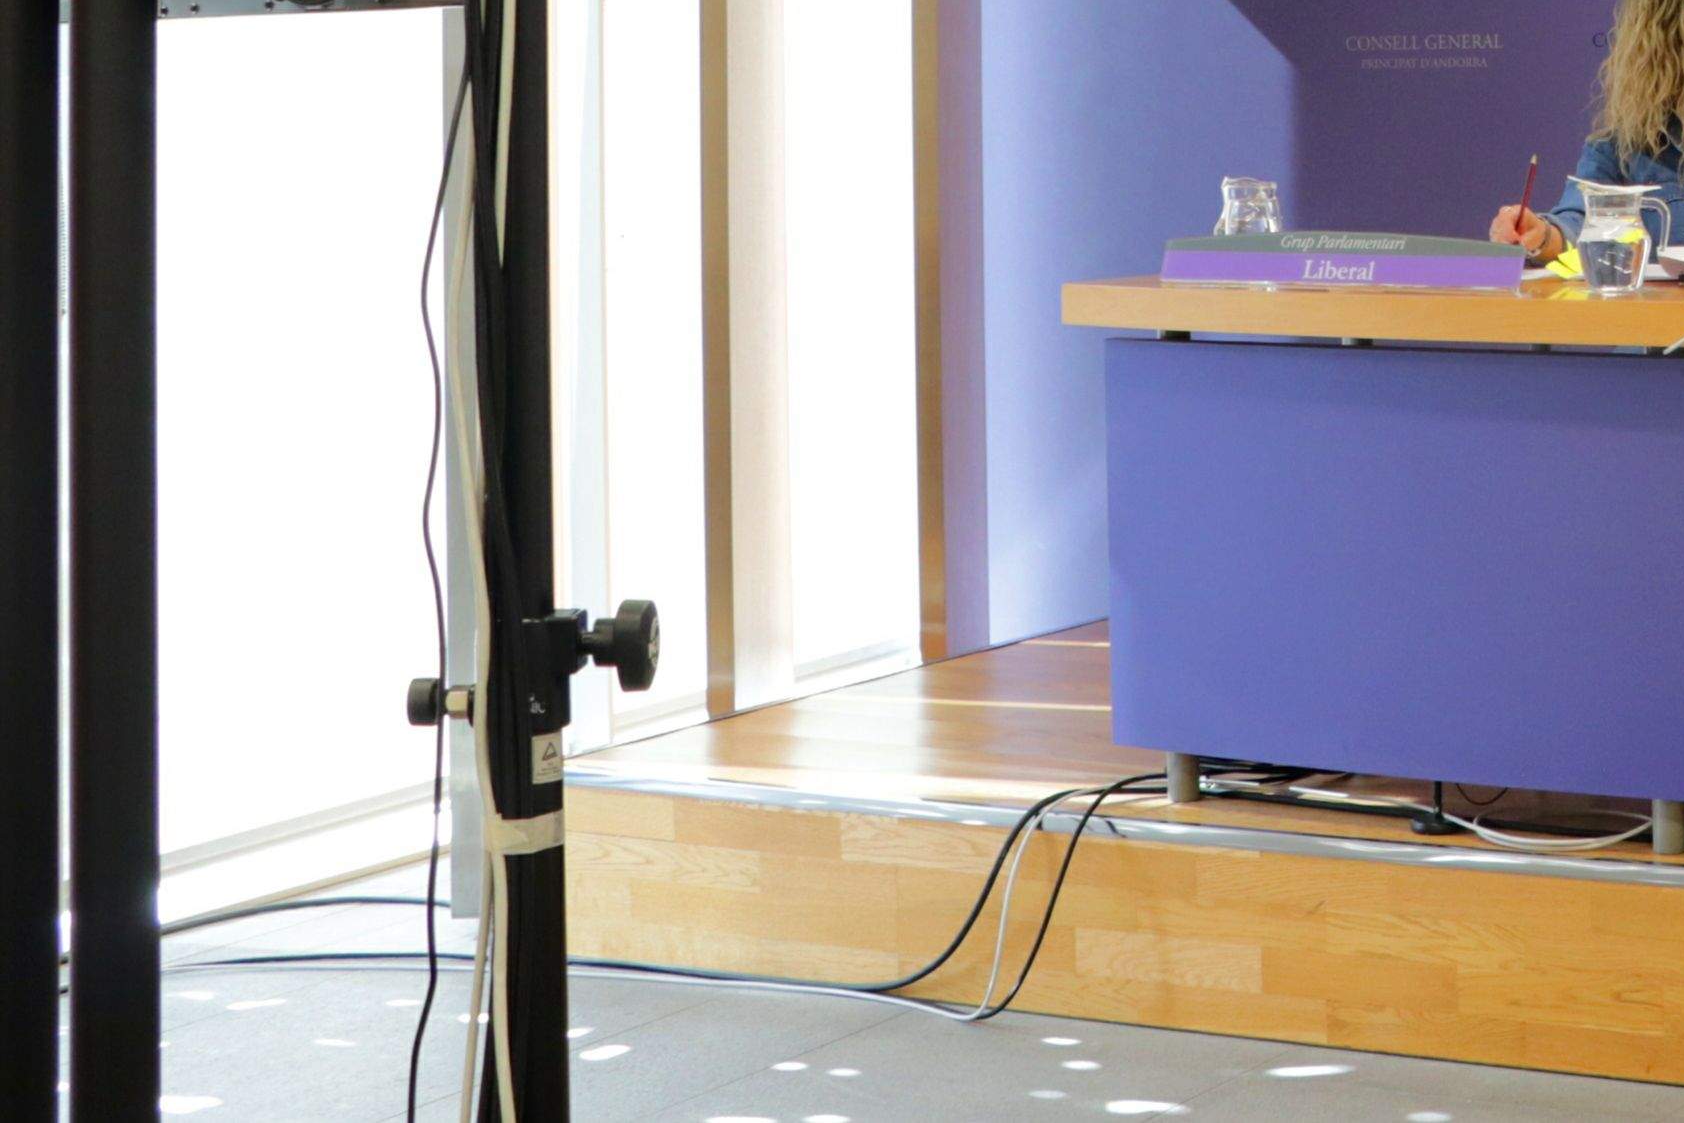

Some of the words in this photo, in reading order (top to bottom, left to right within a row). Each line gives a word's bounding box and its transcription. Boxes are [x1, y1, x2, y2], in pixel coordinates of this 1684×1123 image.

[1345, 34, 1420, 52] CONSELL
[1424, 32, 1504, 50] GENERAL
[1360, 57, 1418, 70] PRINCIPAT
[1420, 56, 1489, 70] D'ANDORRA
[1280, 234, 1315, 252] Grup
[1316, 234, 1408, 251] Parlamentari
[1303, 258, 1377, 281] Liberal
